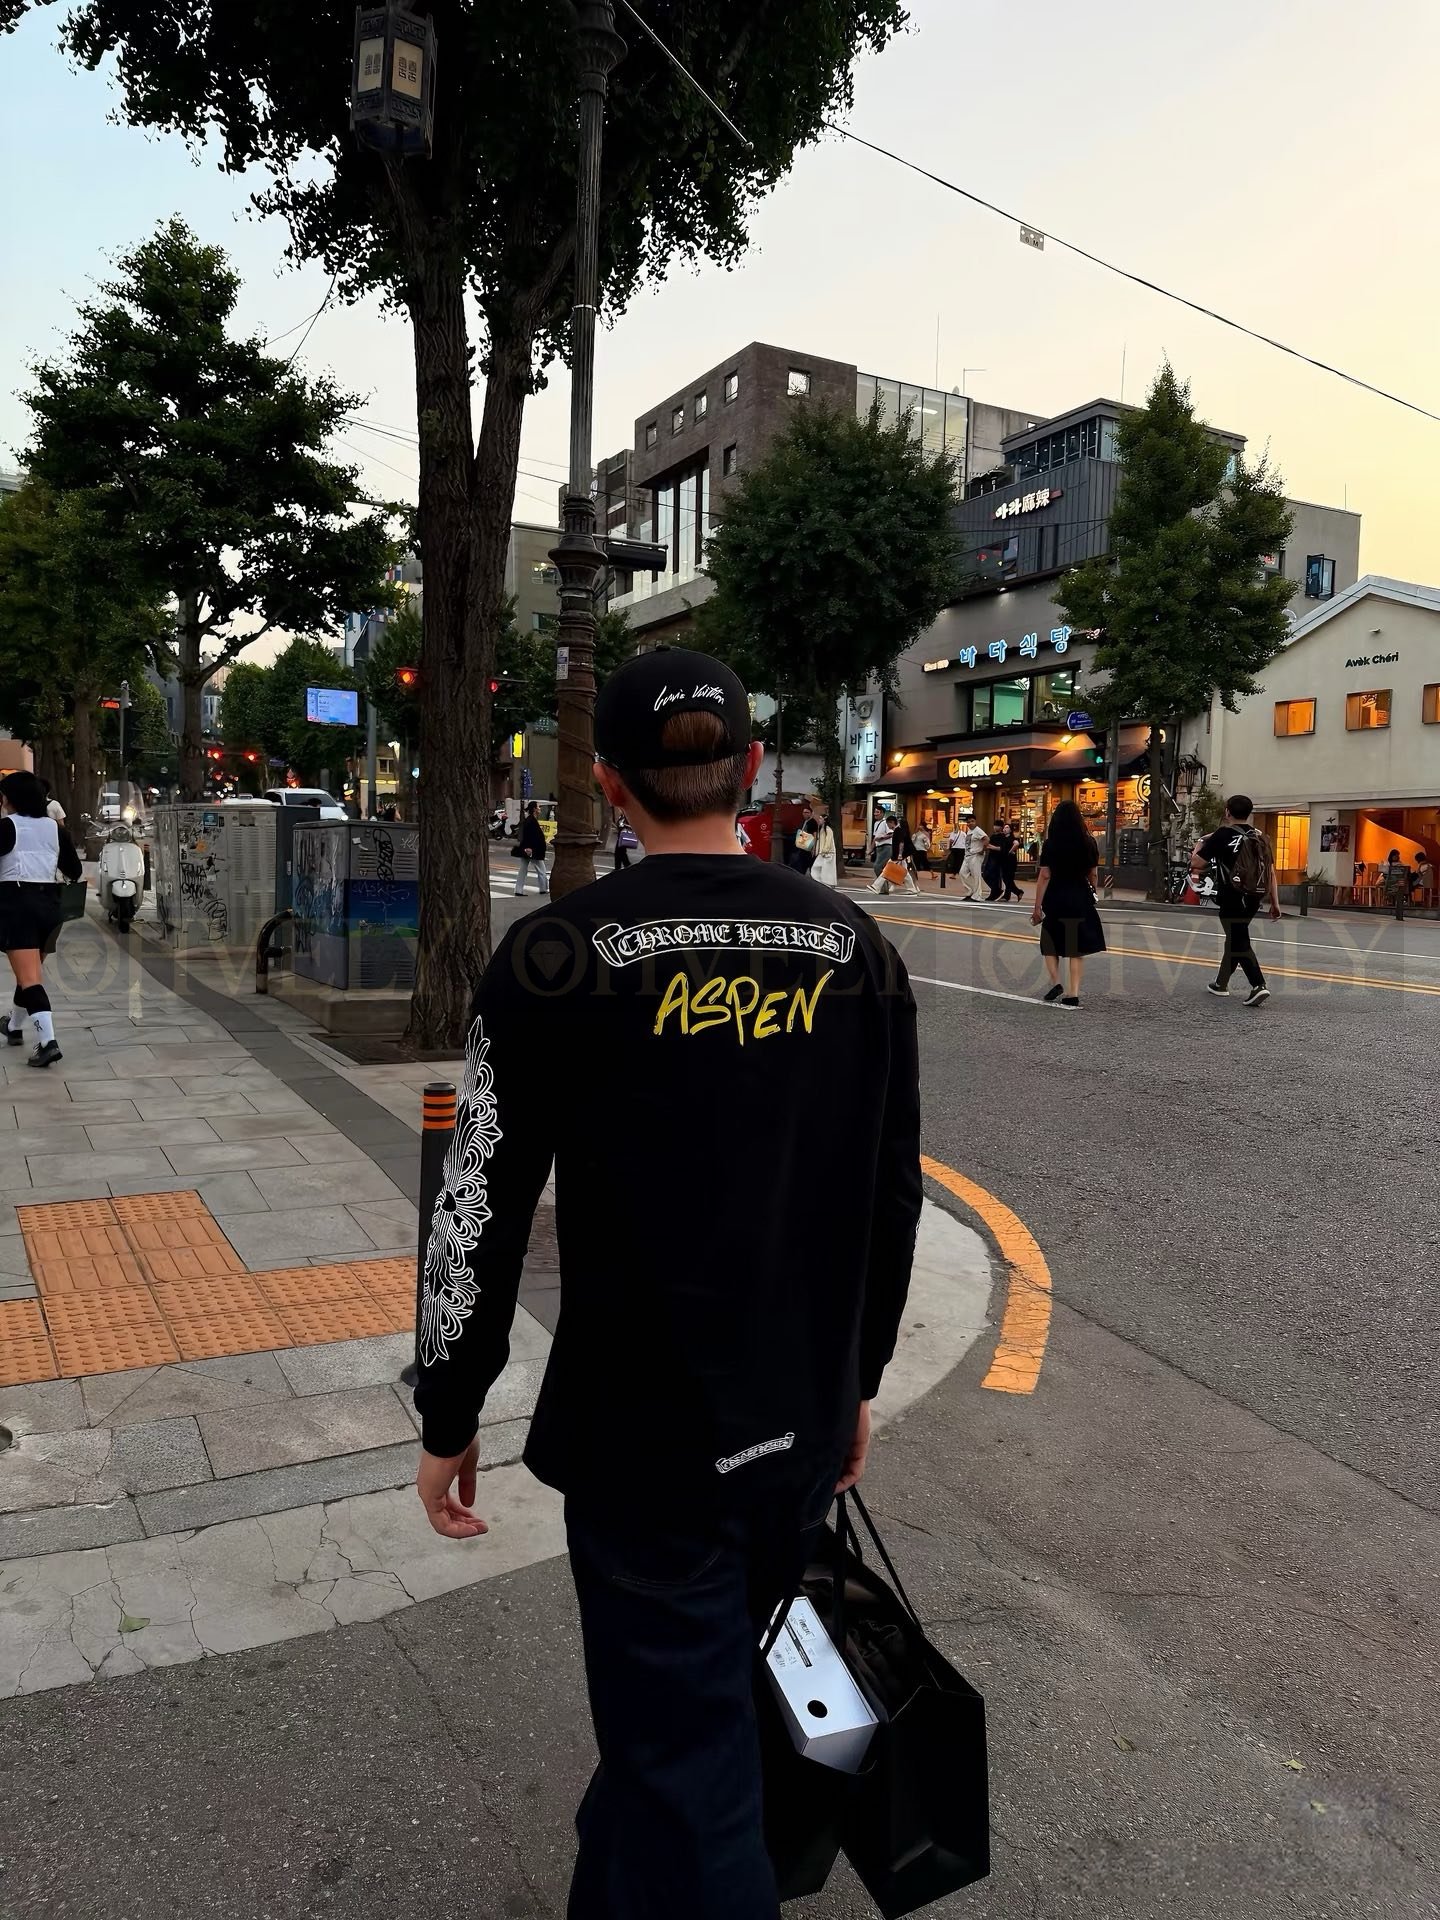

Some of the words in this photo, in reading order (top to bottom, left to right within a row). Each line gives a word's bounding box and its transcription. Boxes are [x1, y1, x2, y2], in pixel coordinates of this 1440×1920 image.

[959, 625, 1073, 669] 바다식당
[850, 730, 879, 752] 바다
[849, 753, 878, 773] 식당
[948, 754, 1009, 779] emart24
[618, 924, 731, 956] CHROME
[734, 922, 840, 955] HEARTS
[653, 969, 834, 1046] ASPEN
